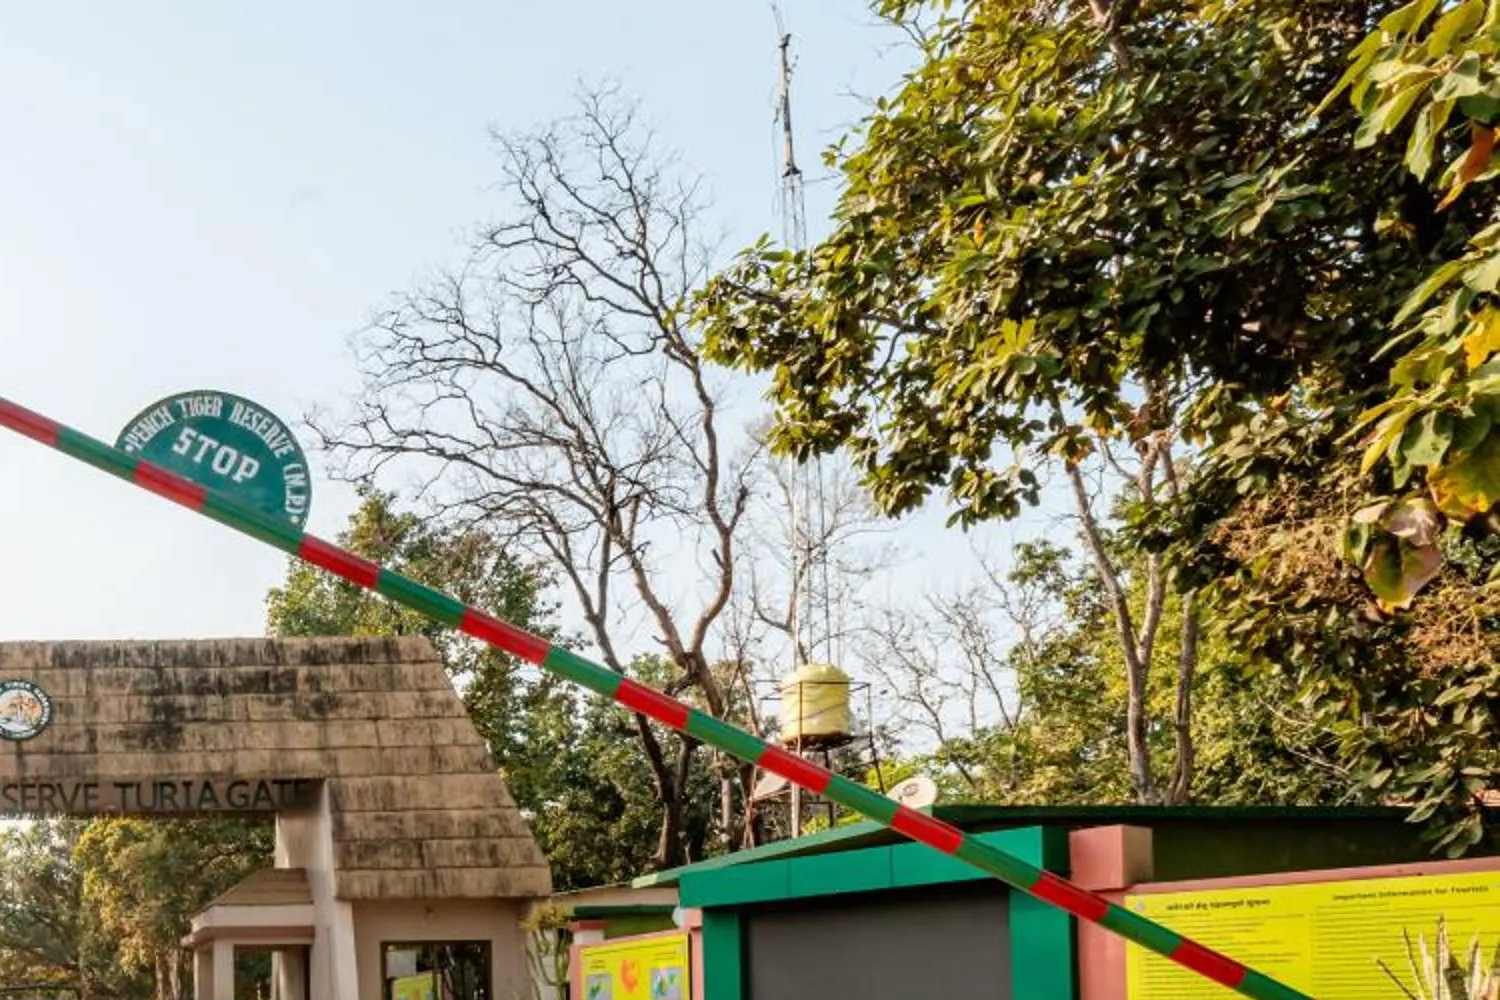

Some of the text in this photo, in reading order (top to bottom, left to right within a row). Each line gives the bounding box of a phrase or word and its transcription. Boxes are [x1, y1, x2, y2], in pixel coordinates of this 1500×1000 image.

[125, 403, 175, 450] PENCH
[177, 396, 224, 418] TIGER
[229, 401, 295, 459] RESERVE
[172, 427, 260, 482] STOP
[114, 781, 219, 812] TURIA
[226, 778, 309, 810] GATE
